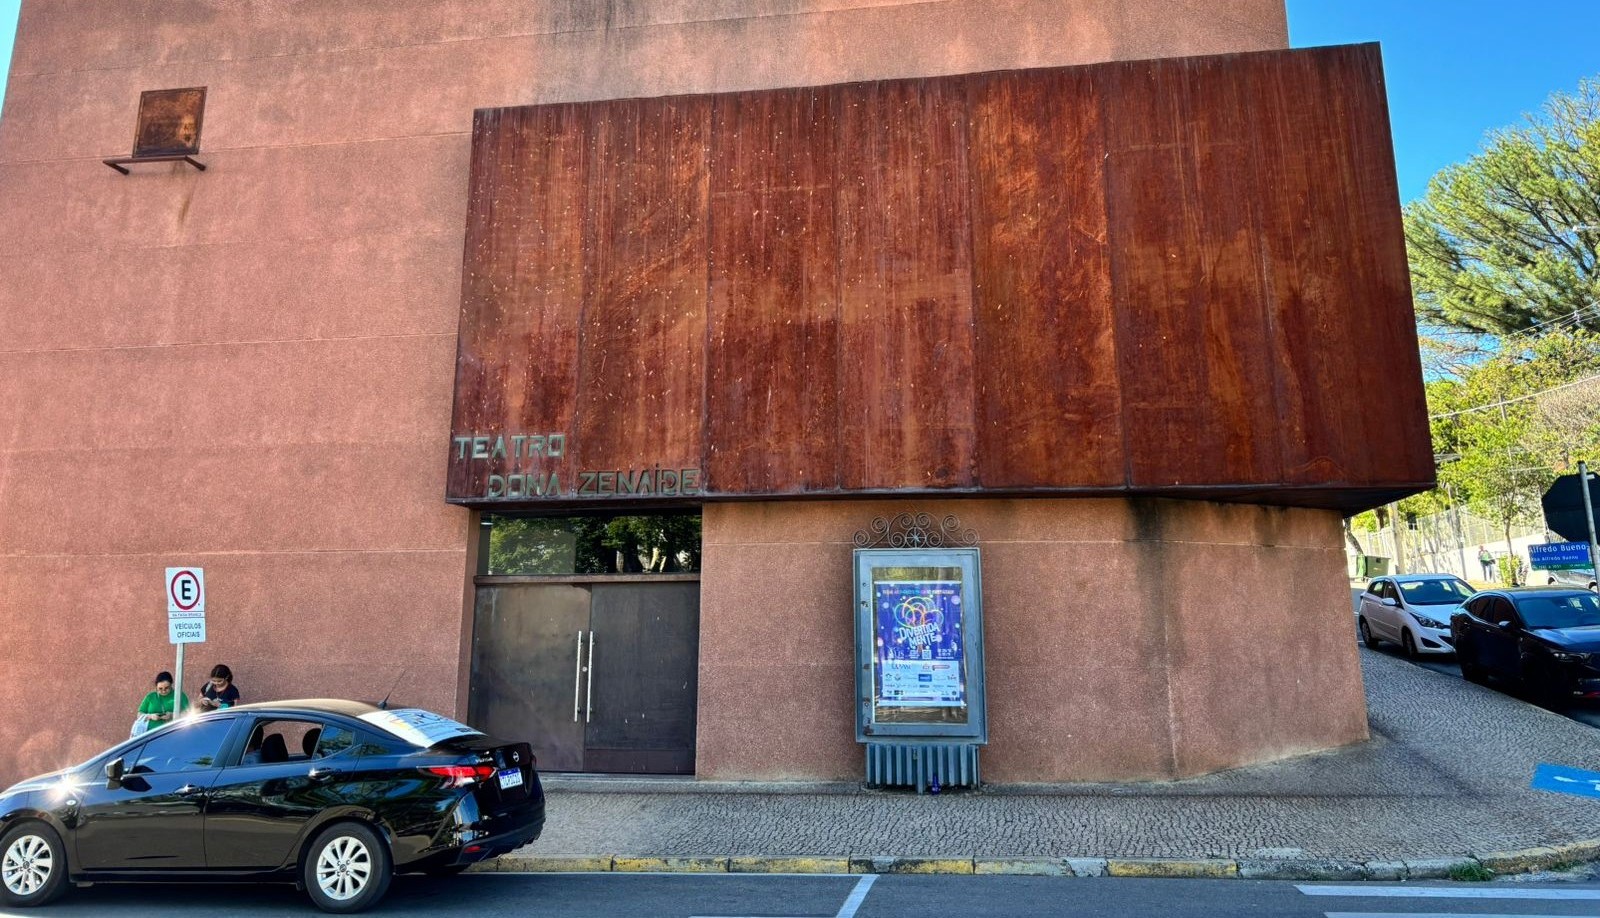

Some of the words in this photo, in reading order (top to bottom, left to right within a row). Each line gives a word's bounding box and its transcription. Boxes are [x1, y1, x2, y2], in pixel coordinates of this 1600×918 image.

[455, 434, 566, 459] TEATRO
[488, 473, 562, 497] DONA
[181, 579, 192, 600] E
[175, 622, 202, 630] VEÍCULOS
[898, 622, 941, 641] DIVERTIDA
[908, 633, 938, 650] MENTE
